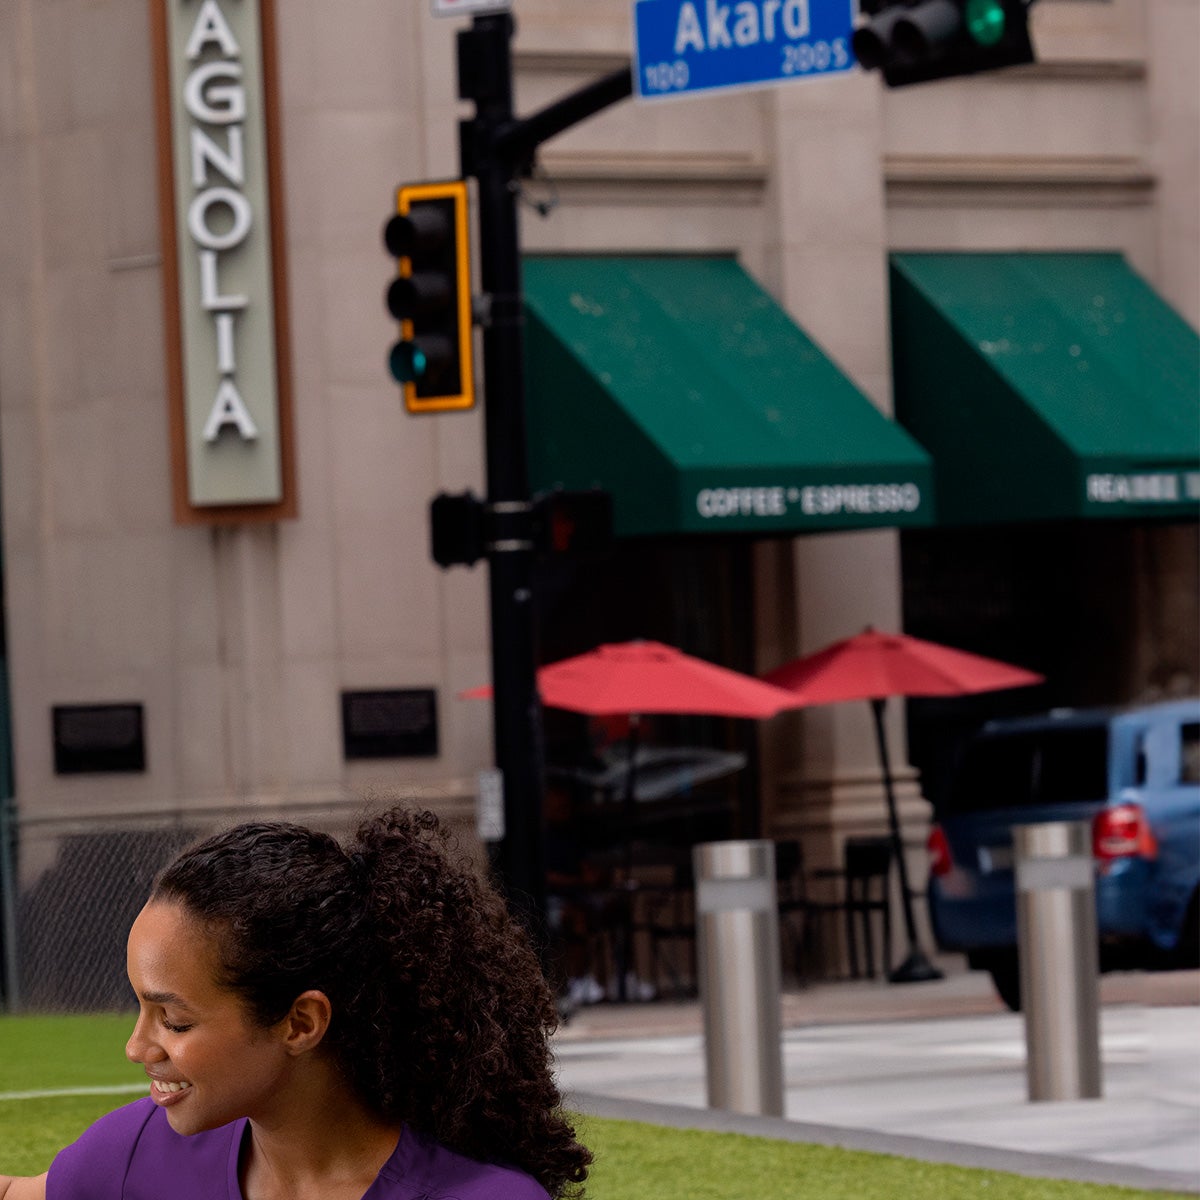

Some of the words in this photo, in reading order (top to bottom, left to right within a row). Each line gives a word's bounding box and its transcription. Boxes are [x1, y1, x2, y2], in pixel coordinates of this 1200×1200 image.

[674, 0, 810, 54] Akard
[646, 60, 690, 90] 100
[183, 0, 259, 443] AGNOLIA
[696, 487, 786, 518] COFFEE
[801, 482, 920, 515] ESPRESSO
